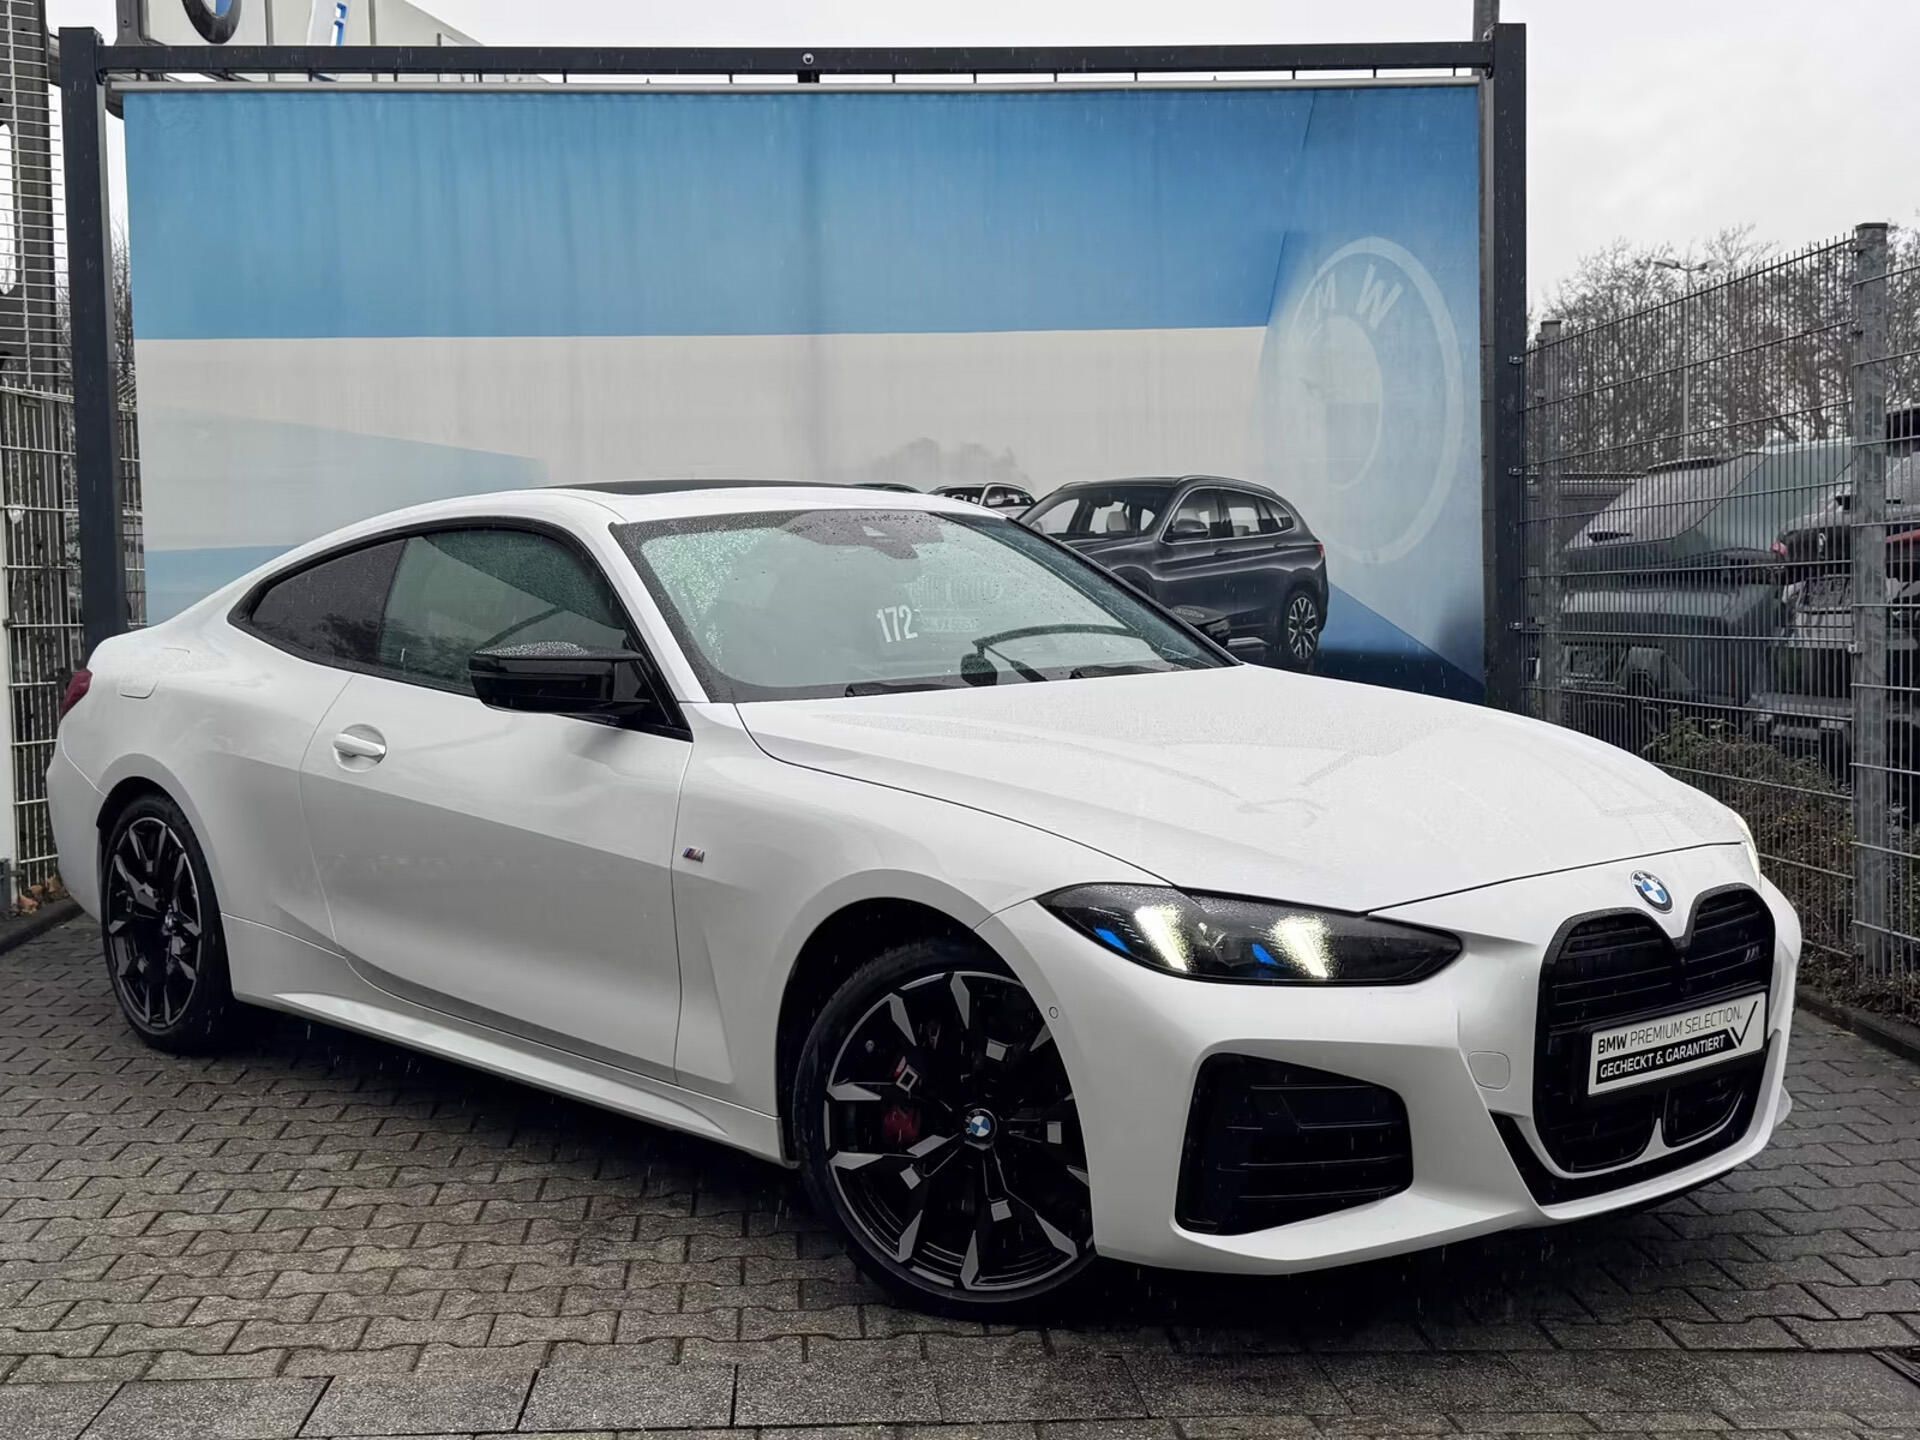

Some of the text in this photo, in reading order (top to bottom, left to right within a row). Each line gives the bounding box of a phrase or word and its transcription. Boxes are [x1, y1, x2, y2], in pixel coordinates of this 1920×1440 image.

[876, 604, 918, 643] 172
[1597, 1032, 1628, 1055] BMW
[1630, 1020, 1682, 1047] PREMIUM
[1600, 1034, 1726, 1078] GECHECKT & GARANTIERT
